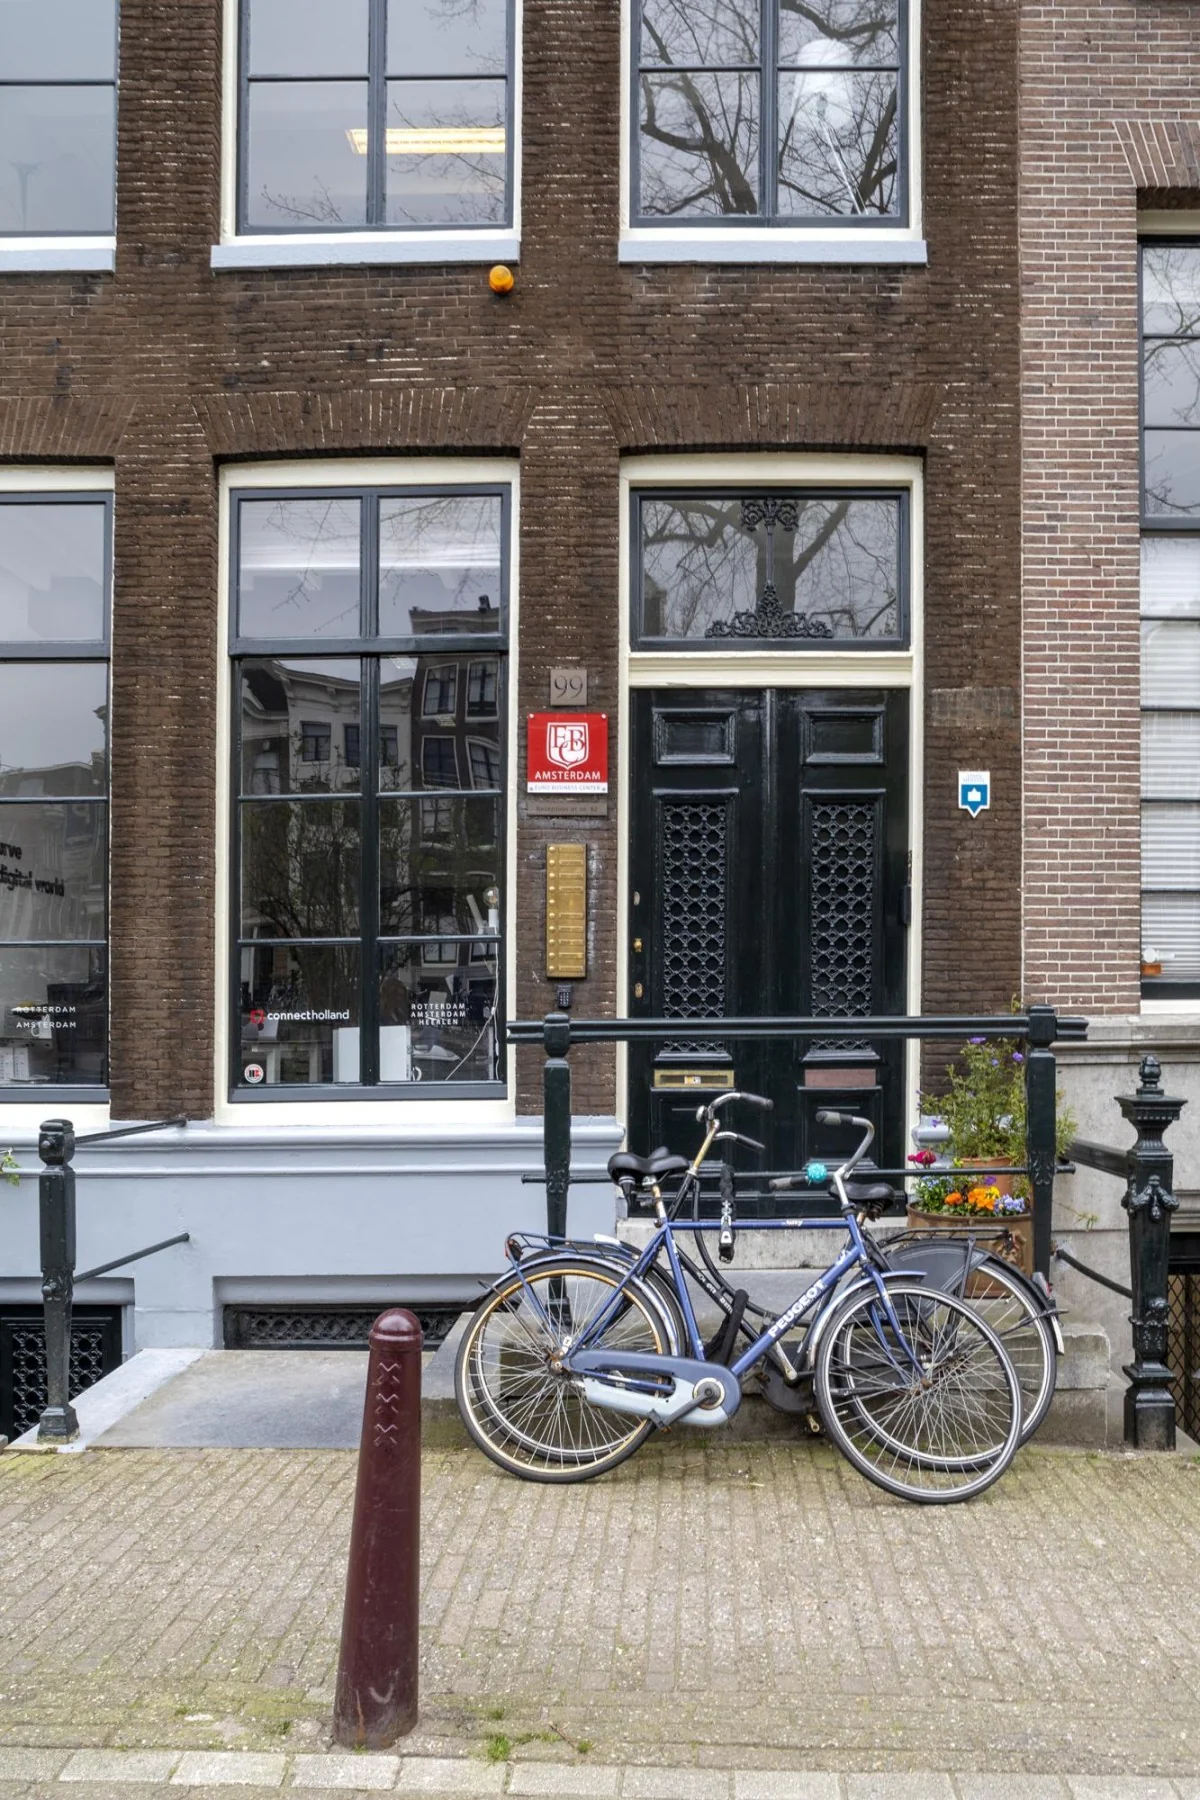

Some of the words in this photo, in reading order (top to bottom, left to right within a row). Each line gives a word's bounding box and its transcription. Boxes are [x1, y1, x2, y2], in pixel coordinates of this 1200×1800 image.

[554, 675, 583, 699] 99
[534, 770, 601, 781] AMSTERDAM
[16, 1006, 77, 1014] ROTTERDAM
[267, 1009, 350, 1020] connectholland
[16, 1021, 77, 1029] AMSTERDAM
[418, 1018, 459, 1026] HEERLEN
[767, 1279, 826, 1338] PEUGEOT
